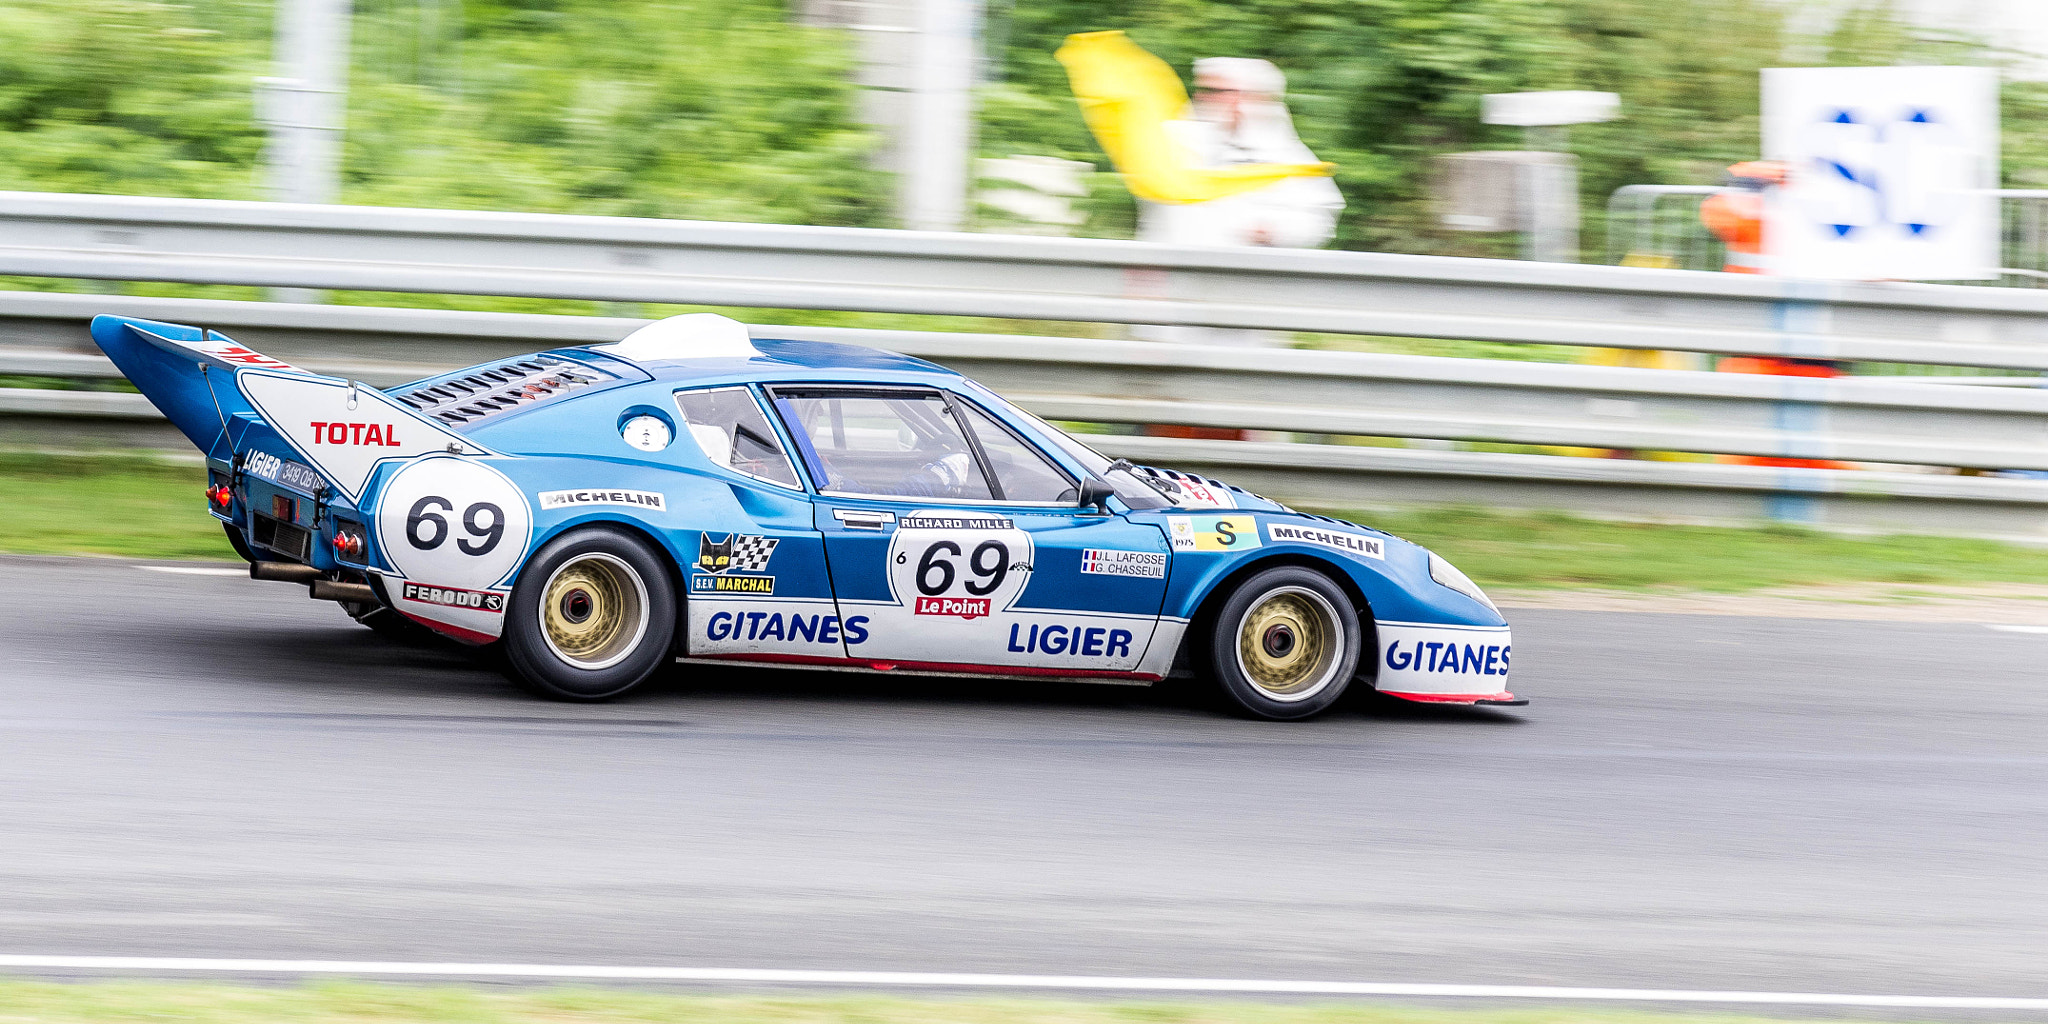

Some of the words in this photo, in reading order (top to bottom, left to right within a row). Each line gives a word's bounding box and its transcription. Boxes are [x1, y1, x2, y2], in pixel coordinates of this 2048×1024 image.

[310, 421, 401, 447] TOTAL
[242, 448, 281, 480] LIGIER
[545, 492, 661, 507] MICHELIN
[406, 495, 505, 556] 69
[901, 518, 963, 529] RICHARD
[968, 518, 1012, 529] MILLE
[1215, 521, 1237, 546] S
[1274, 527, 1380, 555] MICHELIN
[896, 551, 907, 565] 6
[916, 540, 1009, 596] 69
[1095, 563, 1106, 573] G.
[1108, 563, 1164, 577] CHASSEUIL
[1096, 551, 1113, 562] J.L.
[1116, 552, 1165, 566] LAFOSSE
[405, 585, 482, 607] FERODO
[695, 578, 714, 589] S.E.V.
[716, 577, 772, 592] MARCHAL
[920, 599, 939, 613] Le
[941, 599, 986, 615] Point
[707, 611, 870, 645] GITANES
[1007, 623, 1134, 658] LIGIER
[1386, 639, 1512, 676] GITANES
